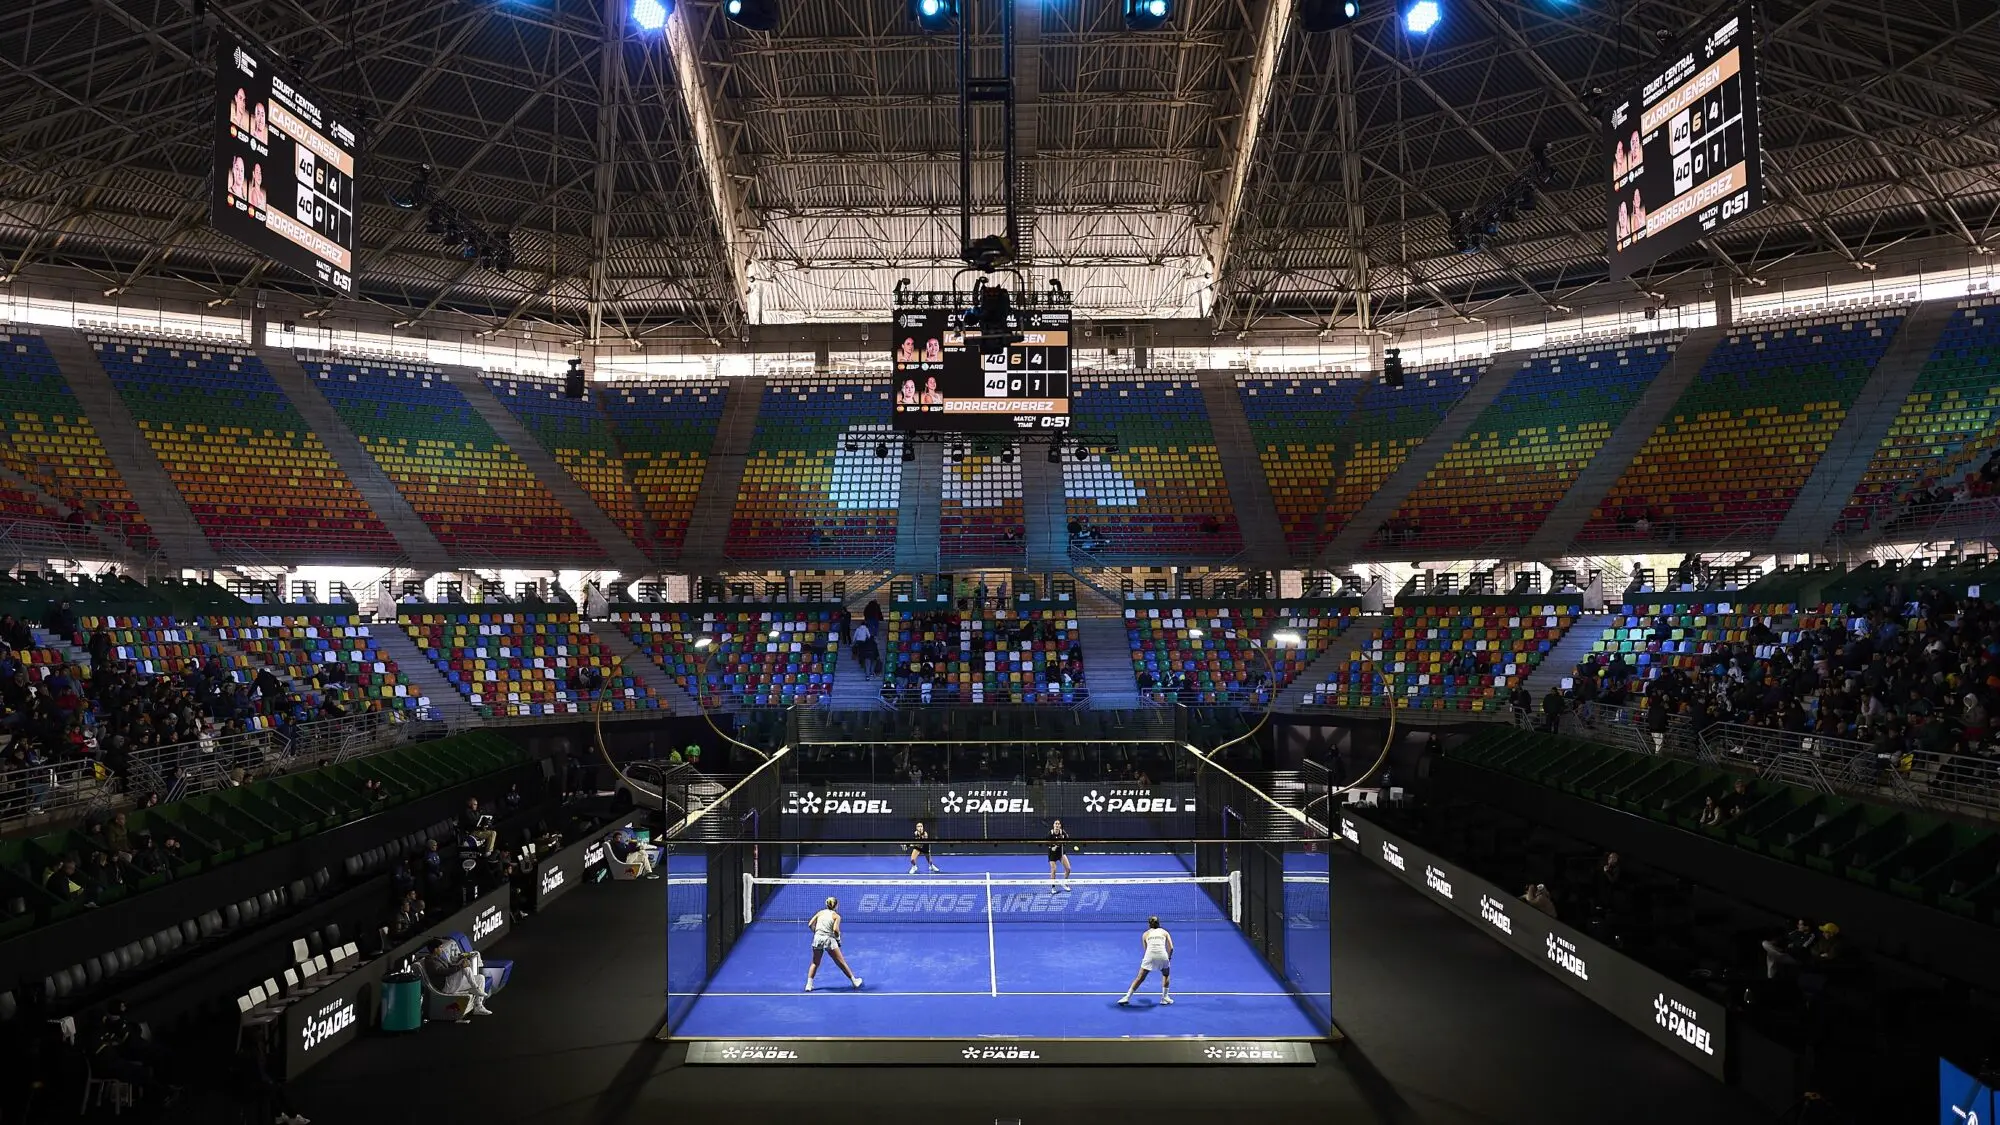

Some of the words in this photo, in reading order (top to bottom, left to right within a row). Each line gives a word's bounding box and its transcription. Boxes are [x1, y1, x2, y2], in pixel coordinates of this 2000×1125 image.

[1643, 74, 1664, 98] COURT
[1665, 53, 1694, 82] CENTRAL
[273, 76, 294, 98] COURT
[294, 93, 322, 120] CENTRAL
[1642, 65, 1720, 133] ICARDO/JENSEN
[1674, 122, 1688, 142] 40
[1692, 112, 1701, 132] 6
[1709, 102, 1718, 120] 4
[269, 104, 340, 165] ICARDO/JENSEN
[1676, 162, 1690, 182] 40
[1694, 154, 1704, 174] 0
[1714, 144, 1718, 162] 1
[300, 159, 313, 178] 40
[316, 168, 324, 185] 6
[329, 177, 336, 194] 4
[1647, 172, 1732, 231] BORRERO/PEREZ
[1722, 191, 1748, 220] 0:51
[298, 196, 312, 214] 40
[315, 206, 323, 222] 0
[330, 214, 335, 230] 1
[1699, 206, 1718, 222] MATCH
[1702, 218, 1716, 230] TIME
[267, 211, 342, 264] BORRERO/PEREZ
[316, 260, 332, 274] MATCH
[318, 270, 330, 282] TIME
[333, 270, 352, 292] 0:51
[986, 355, 1006, 364] 40
[1010, 354, 1022, 364] 6
[1030, 354, 1042, 364] 4
[986, 380, 1006, 390] 40
[1010, 380, 1022, 390] 0
[1034, 380, 1040, 390] 1
[945, 402, 1054, 411] BORRERO/PEREZ
[1041, 416, 1070, 428] 0:51
[824, 800, 892, 814] PADEL
[965, 799, 1034, 813] PADEL
[1108, 798, 1177, 812] PADEL
[1388, 850, 1405, 871] PADEL
[547, 871, 564, 892] PADEL
[1432, 876, 1452, 899] PADEL
[858, 894, 977, 912] BUENOS
[981, 892, 1071, 912] AIRES
[1489, 898, 1504, 911] PREMIER
[481, 911, 503, 938] PADEL
[1488, 908, 1512, 935] PADEL
[1557, 936, 1576, 952] PREMIER
[1556, 948, 1588, 980] PADEL
[319, 998, 342, 1018] PREMIER
[1670, 999, 1696, 1020] PREMIER
[317, 1004, 356, 1044] PADEL
[1668, 1012, 1714, 1056] PADEL
[741, 1050, 798, 1058] PADEL
[982, 1050, 1040, 1058] PADEL
[1226, 1050, 1284, 1058] PADEL
